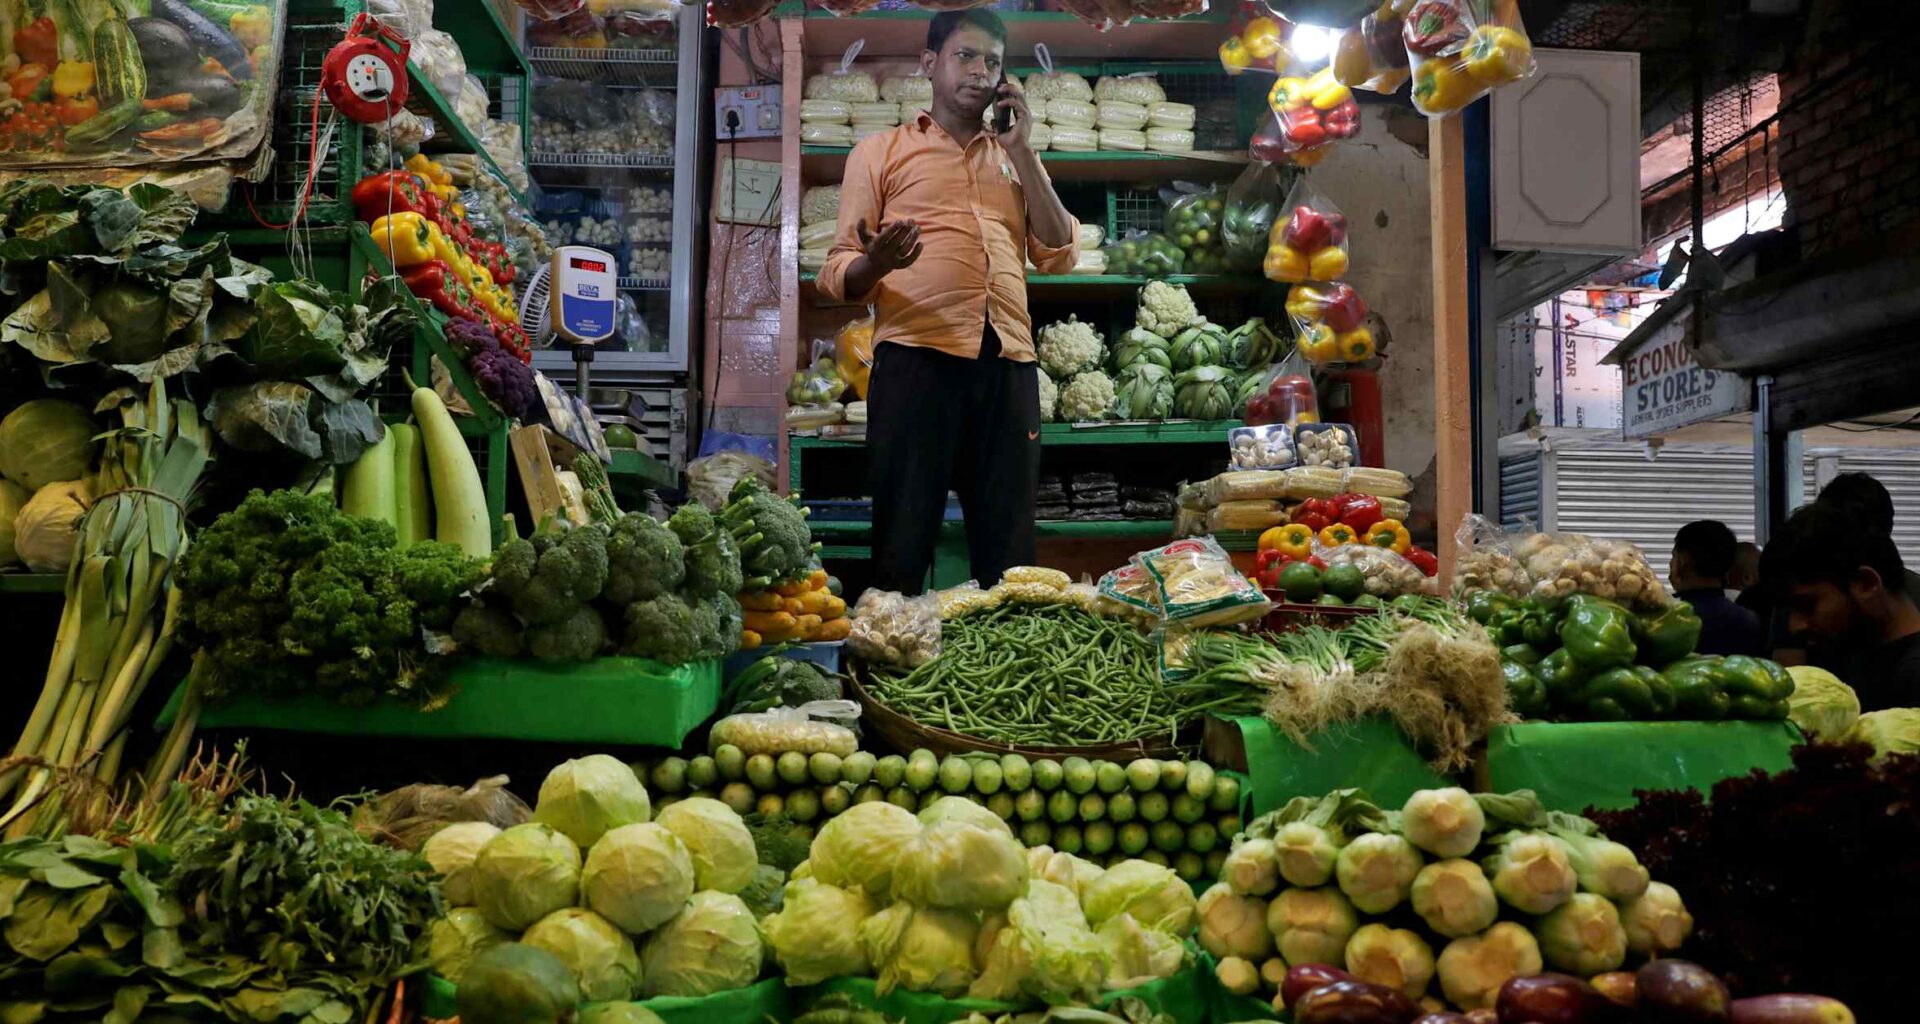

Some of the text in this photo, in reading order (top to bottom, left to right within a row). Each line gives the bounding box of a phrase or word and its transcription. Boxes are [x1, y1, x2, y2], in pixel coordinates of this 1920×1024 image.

[1564, 313, 1581, 378] ALSTAR
[1626, 339, 1692, 387] ECONO
[1637, 367, 1716, 412] STORES
[1675, 393, 1712, 414] SUPPLIERS
